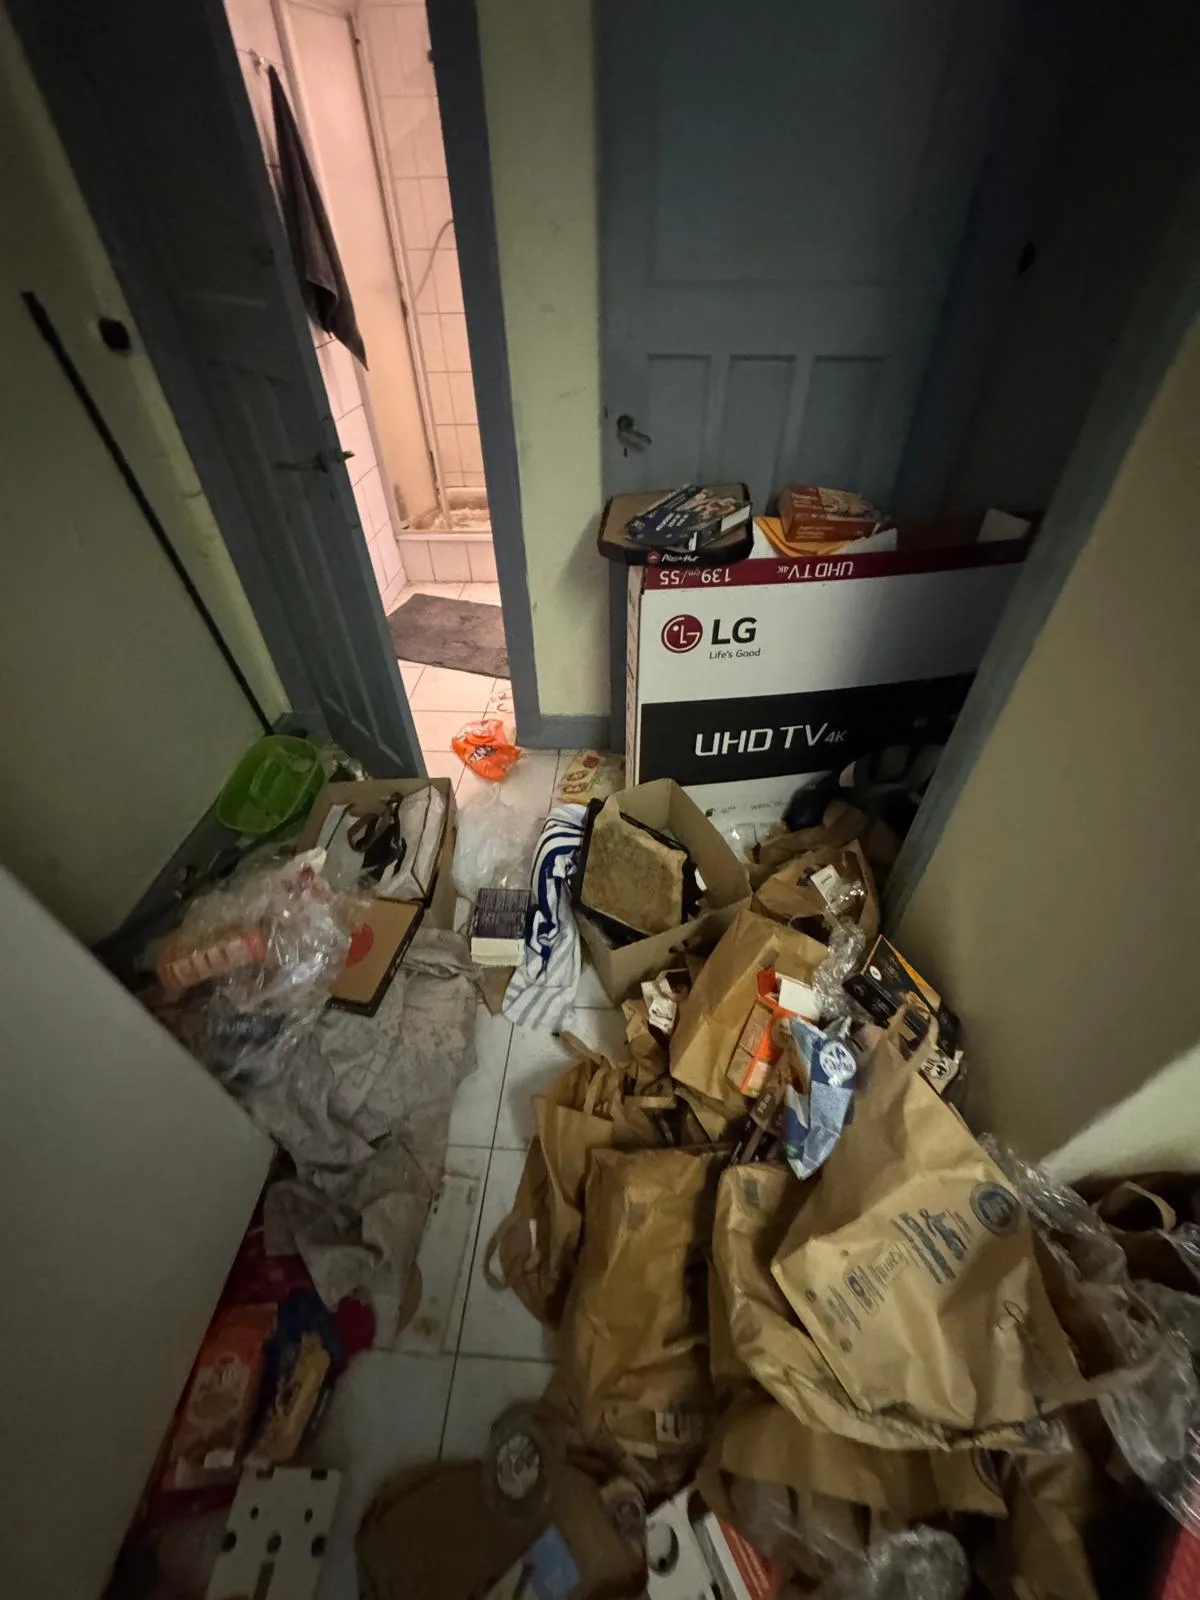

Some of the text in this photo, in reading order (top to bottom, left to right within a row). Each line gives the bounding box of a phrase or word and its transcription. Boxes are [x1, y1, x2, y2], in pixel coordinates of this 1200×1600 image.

[711, 617, 757, 645] LG
[709, 648, 761, 660] Life's Good
